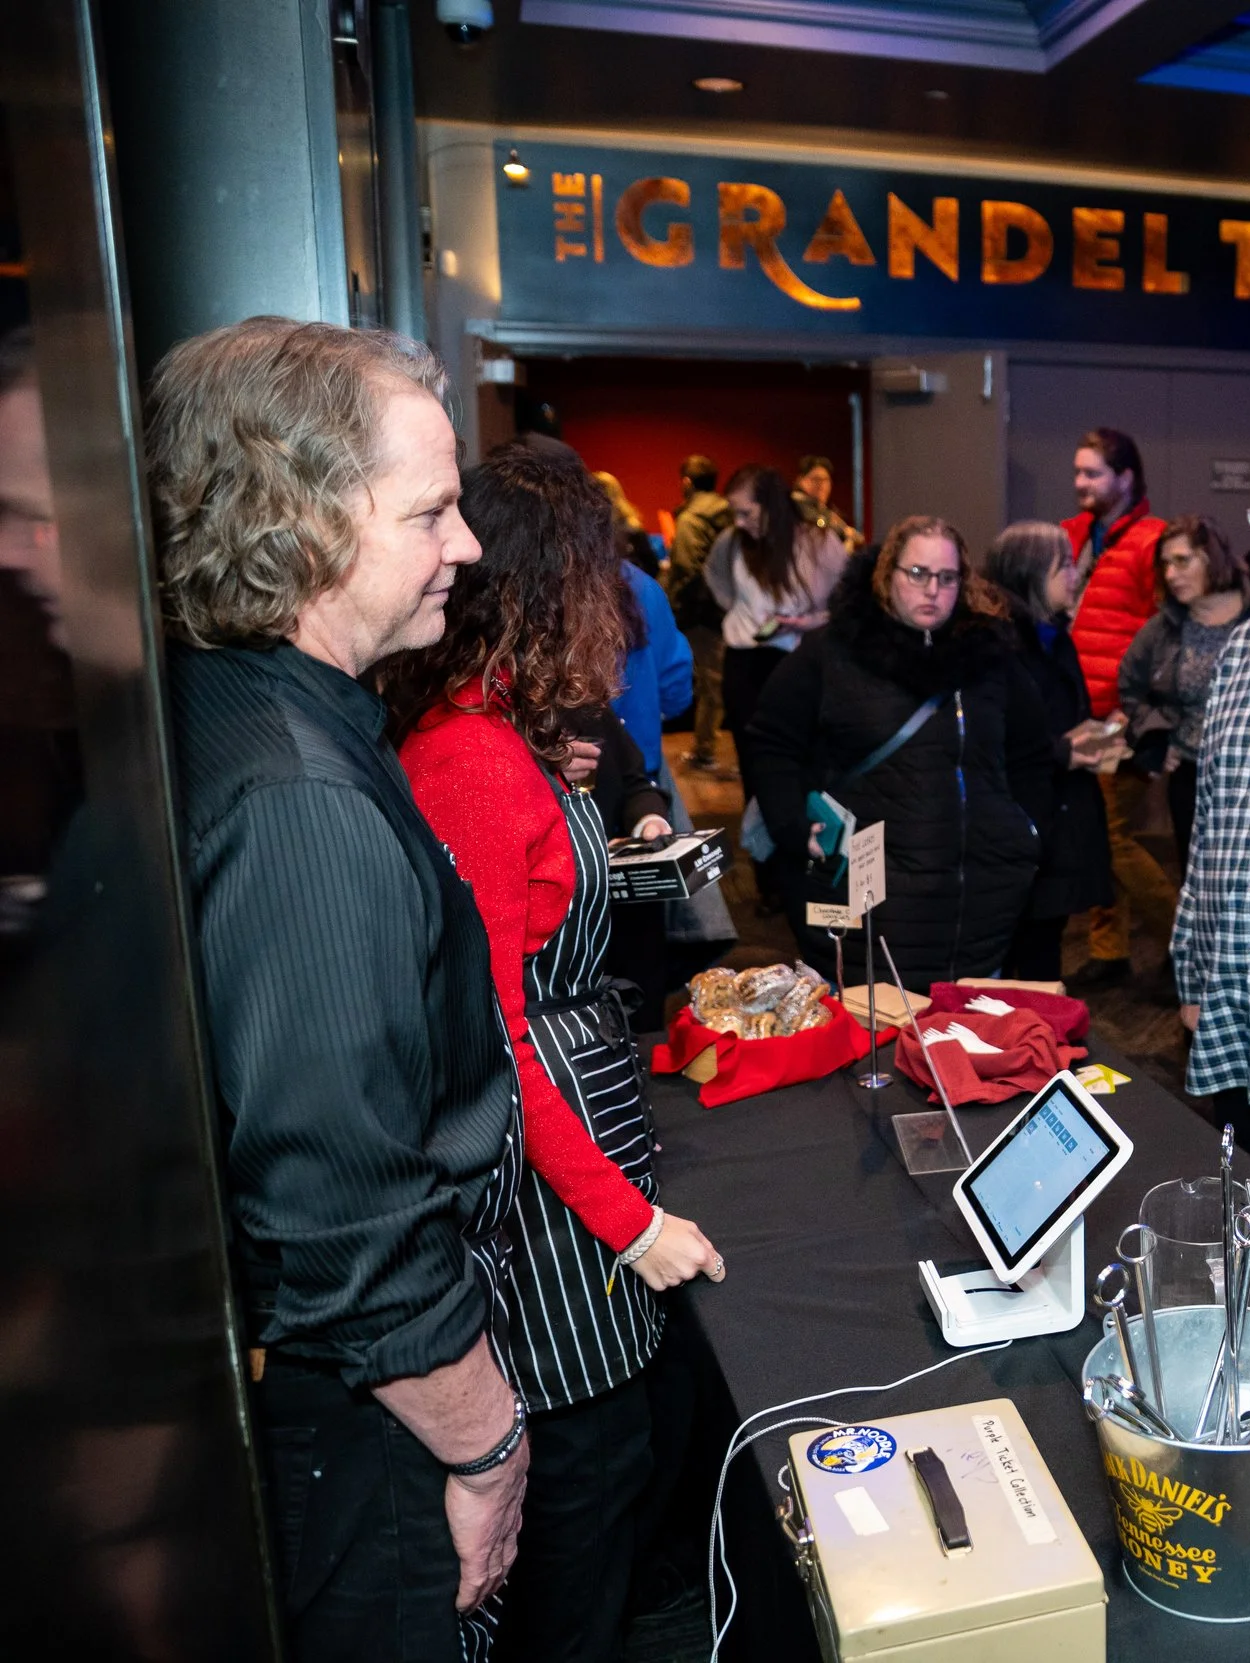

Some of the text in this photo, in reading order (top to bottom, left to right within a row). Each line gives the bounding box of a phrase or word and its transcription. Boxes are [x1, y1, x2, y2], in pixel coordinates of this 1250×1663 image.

[551, 172, 587, 263] THE
[615, 176, 1190, 311] GRANDEL
[983, 1420, 1037, 1518] Purple Ticket Collection
